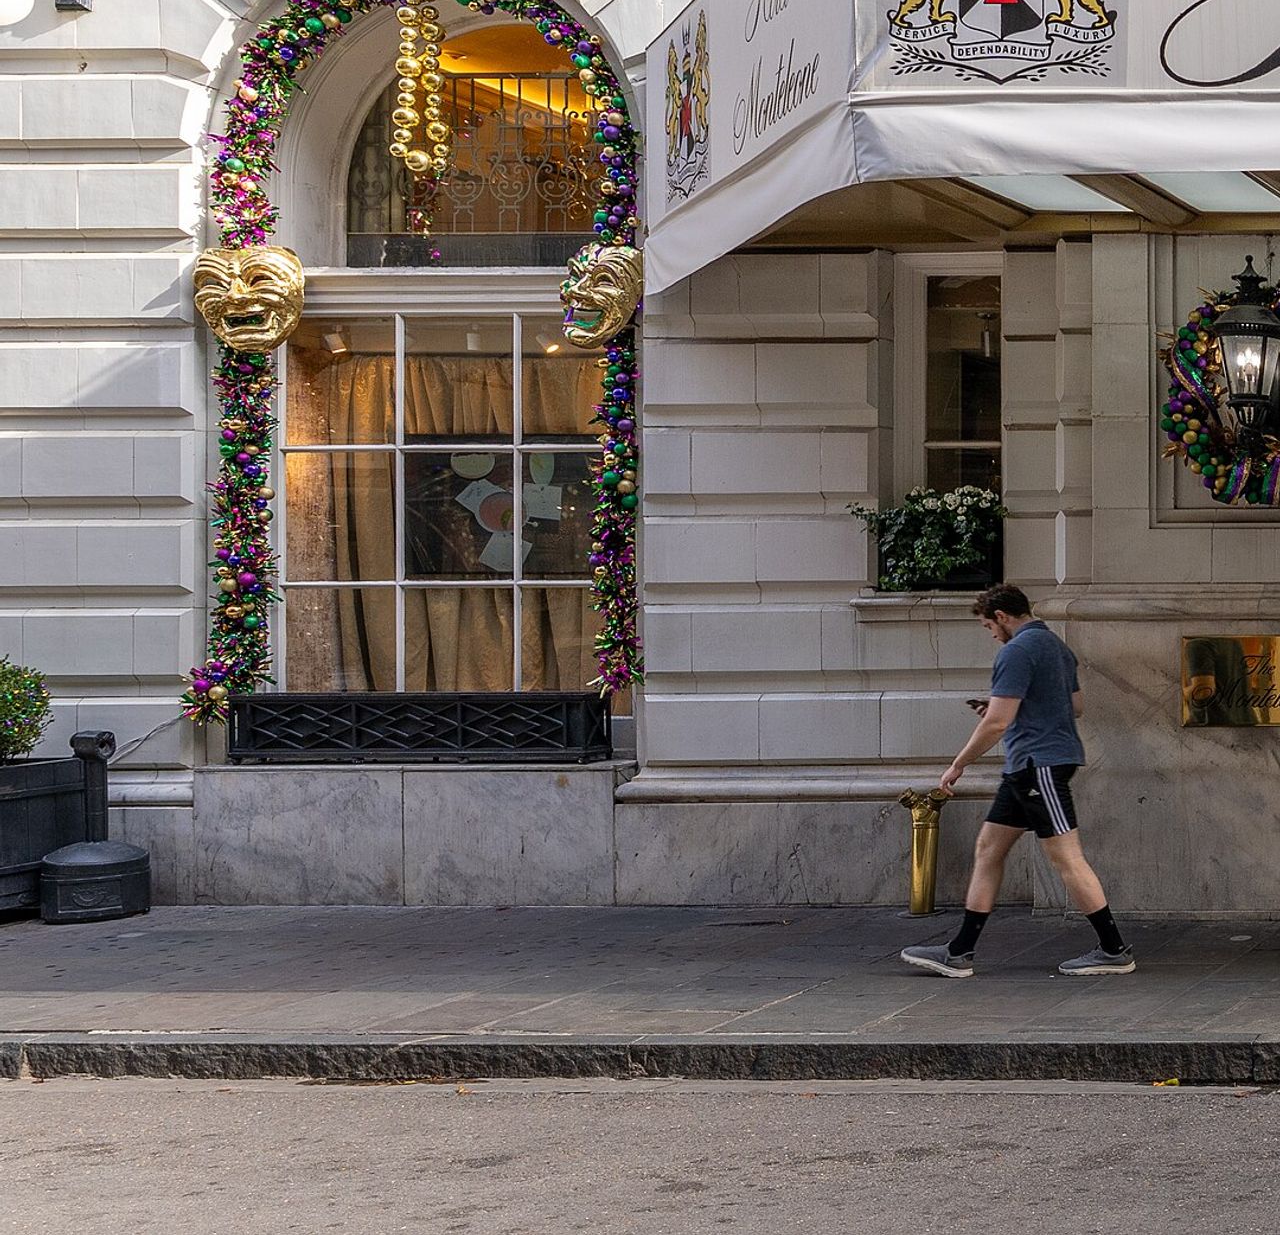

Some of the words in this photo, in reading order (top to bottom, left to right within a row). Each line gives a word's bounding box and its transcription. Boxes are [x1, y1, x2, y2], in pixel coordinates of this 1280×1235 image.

[896, 24, 949, 39] SERVICE
[1053, 24, 1108, 40] LUXURY
[957, 45, 1047, 58] DEPENDABILITY
[733, 38, 820, 155] Monteleone
[1241, 654, 1276, 675] The
